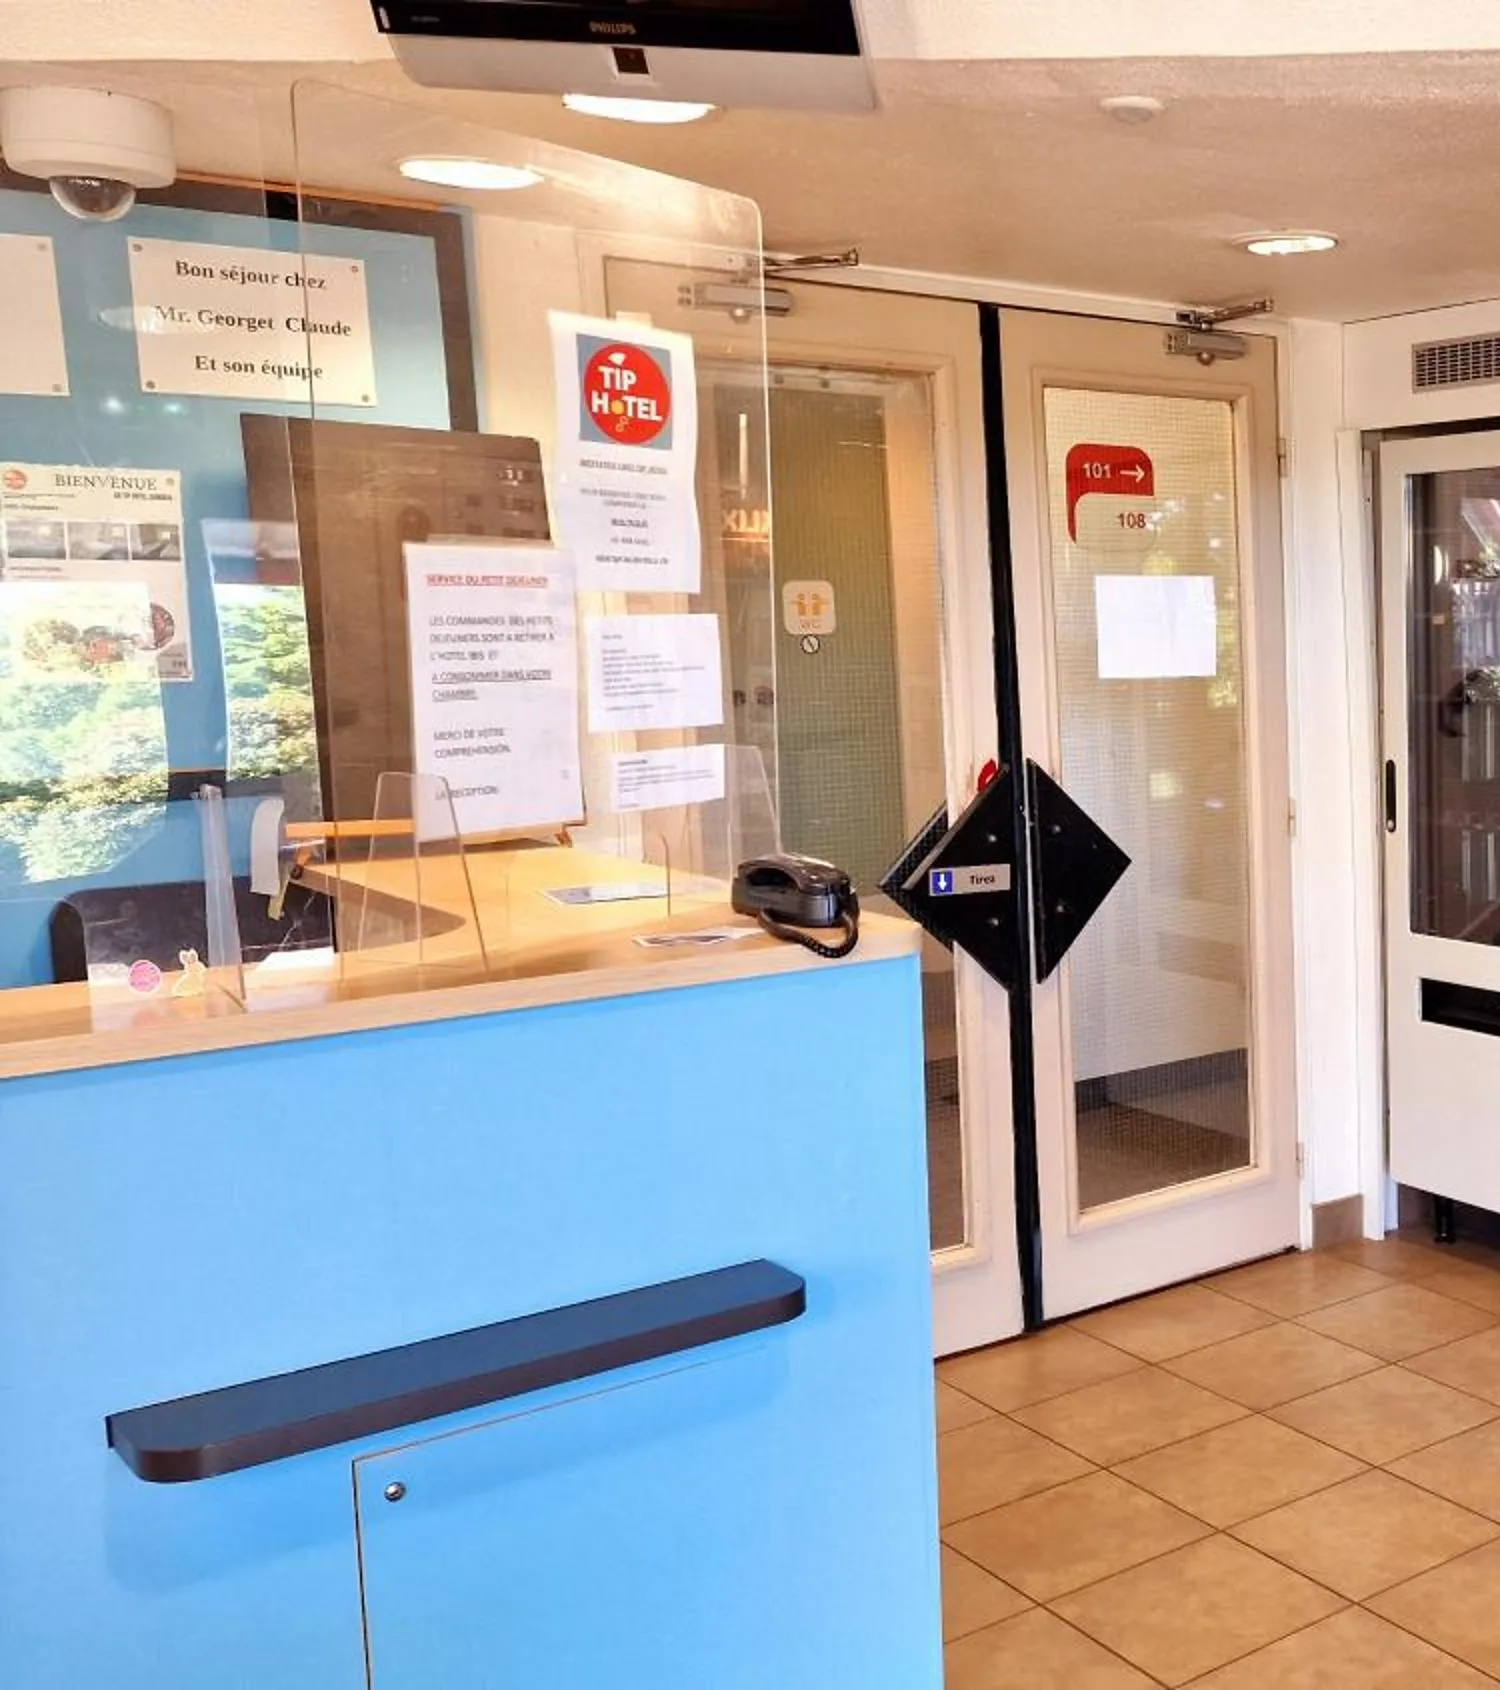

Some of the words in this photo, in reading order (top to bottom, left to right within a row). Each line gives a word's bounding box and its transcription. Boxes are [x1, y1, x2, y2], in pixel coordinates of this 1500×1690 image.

[175, 259, 214, 279] Bon
[219, 264, 280, 286] séjour
[284, 271, 327, 290] chez
[154, 304, 191, 325] Mr.
[197, 308, 274, 332] Georget
[284, 317, 352, 338] Claude
[194, 355, 217, 372] Et
[222, 359, 255, 376] son
[261, 358, 324, 381] équipe
[598, 365, 637, 391] TIP
[1082, 462, 1112, 480] 101
[55, 474, 157, 491] BIENVENUE
[1116, 512, 1146, 530] 108
[429, 616, 443, 627] LES
[509, 616, 524, 627] DES
[464, 729, 474, 739] DE
